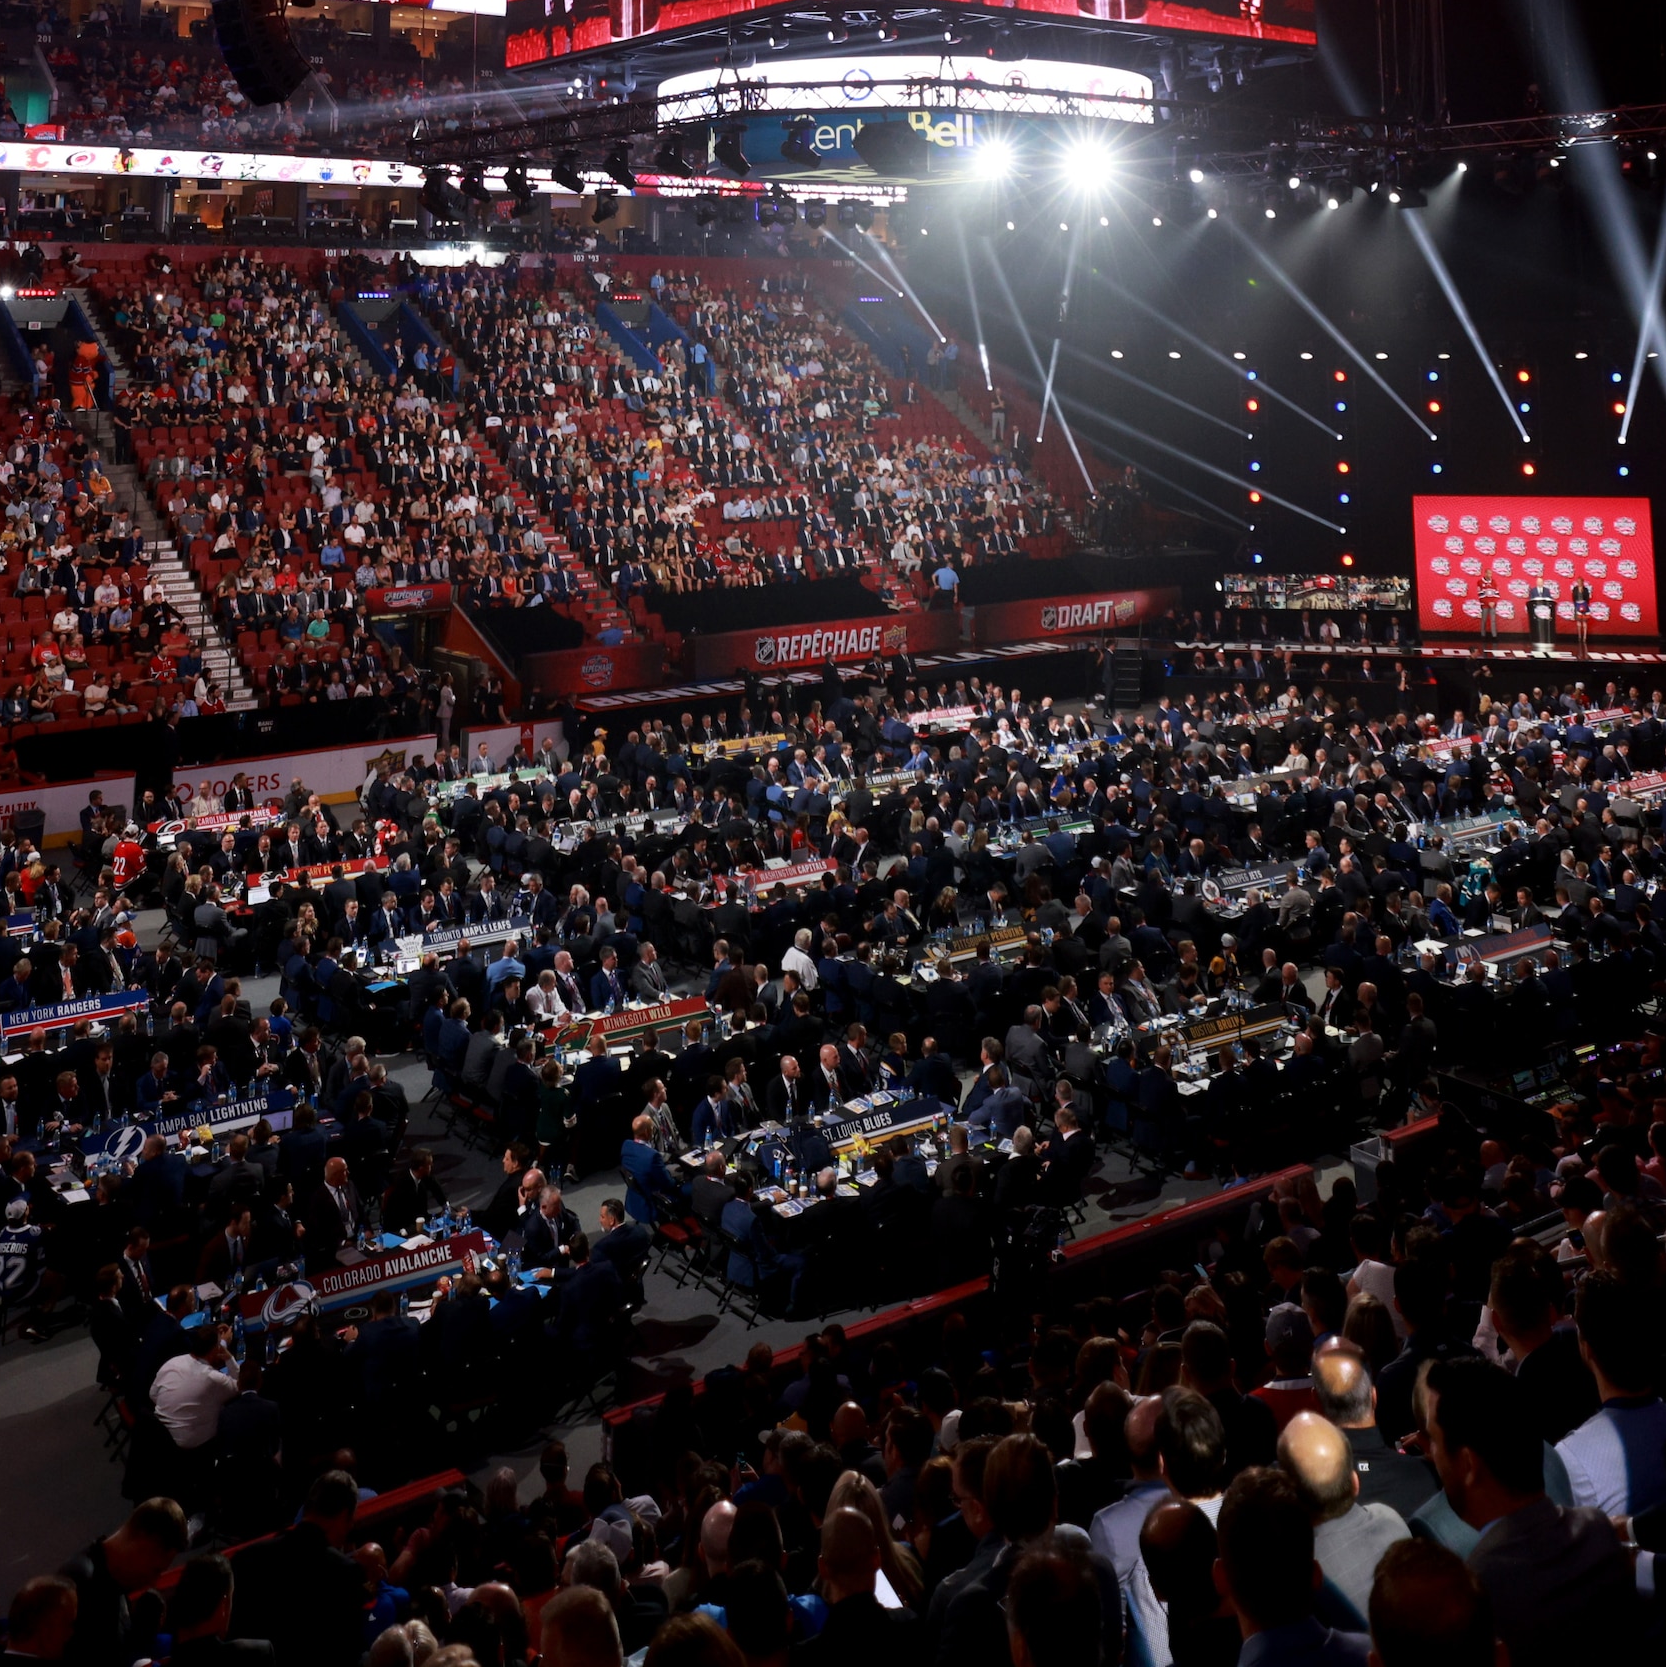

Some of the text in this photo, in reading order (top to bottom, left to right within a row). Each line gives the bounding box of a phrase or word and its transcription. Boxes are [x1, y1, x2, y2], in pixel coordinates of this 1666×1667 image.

[1057, 600, 1114, 628] DRAFT
[776, 626, 883, 663] REPÊCHAGE
[1175, 642, 1405, 654] WELCOME
[1489, 649, 1577, 660] THE
[197, 815, 226, 827] CAROLINA
[759, 861, 828, 883] WASHINGTON CAPITALS
[1220, 869, 1263, 890] WINNIPEG JETS
[428, 919, 512, 943] TORONTO MAPLE LEAFS
[990, 925, 1025, 942] PENGUINS
[9, 998, 102, 1026] NEW YORK RANGERS
[603, 1006, 672, 1030] MINNESOTA WILD
[1190, 1022, 1215, 1039] BOSTON
[153, 1098, 269, 1135] TAMPA BAY LIGHTNING
[821, 1113, 893, 1140] ST. LOUIS BLUES
[322, 1246, 453, 1293] COLORADO AVALANCHE
